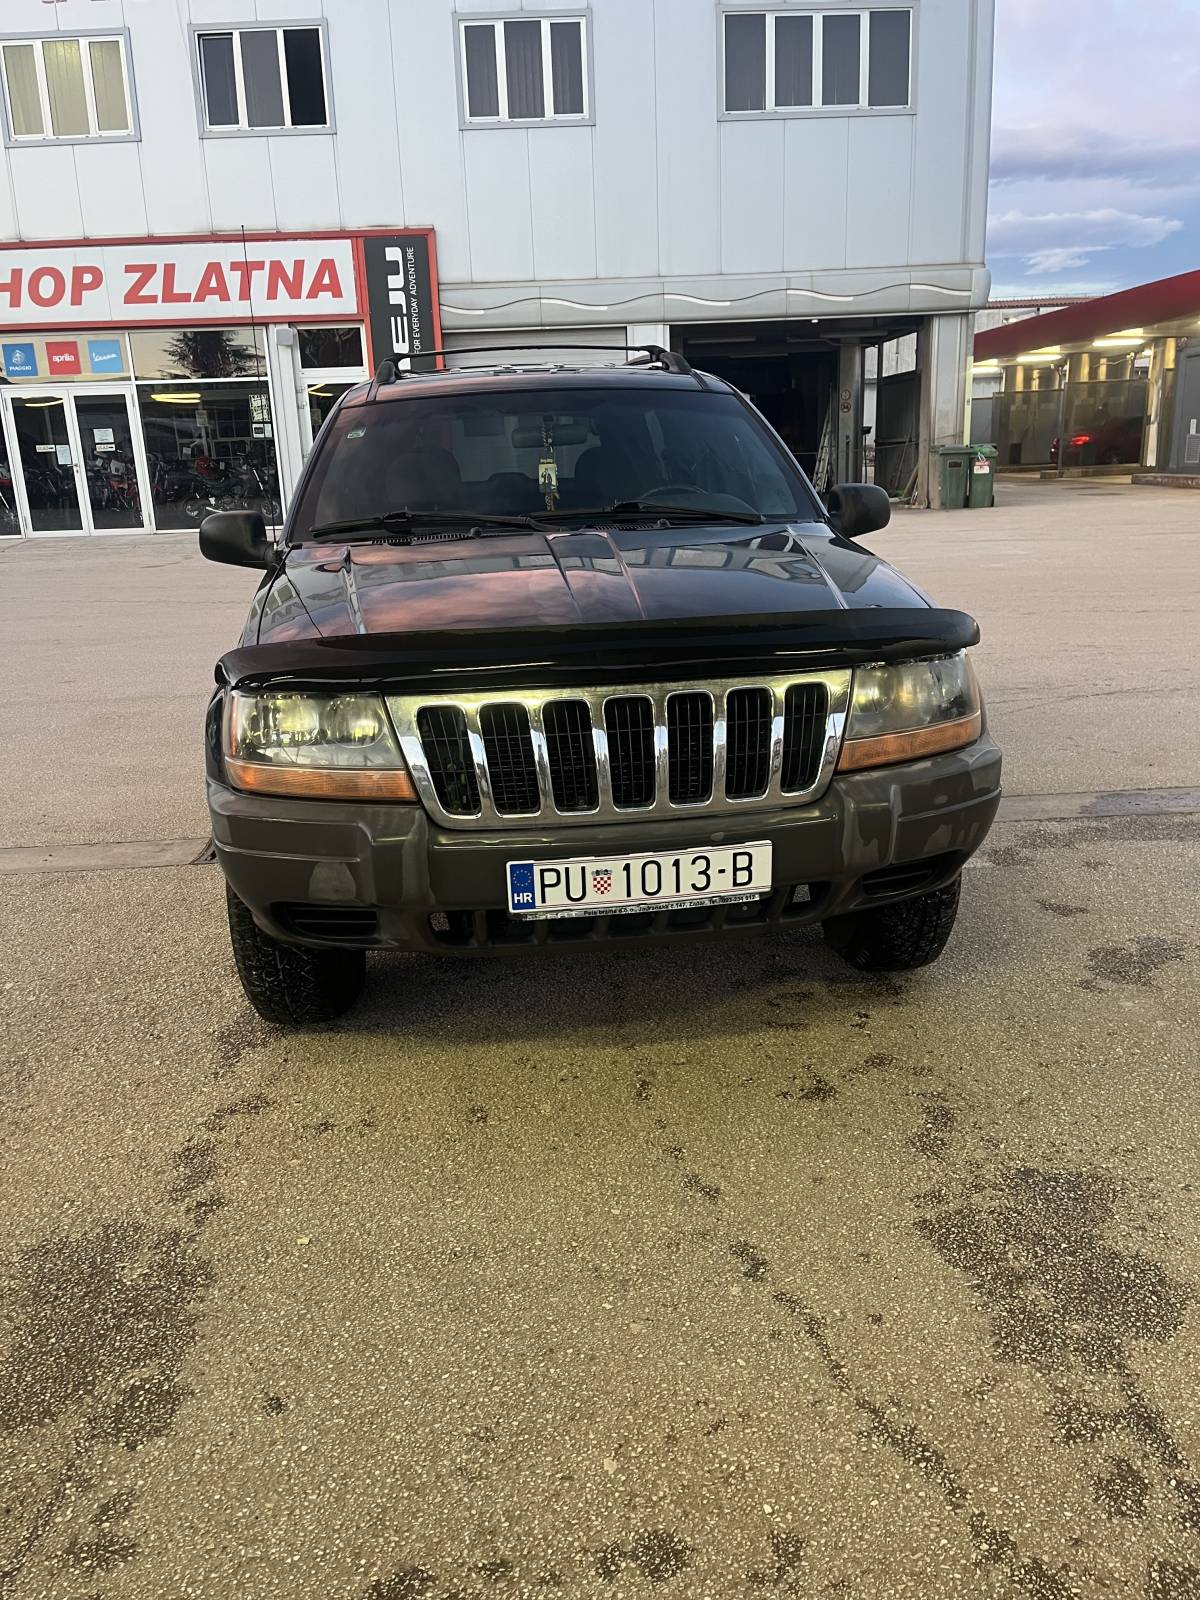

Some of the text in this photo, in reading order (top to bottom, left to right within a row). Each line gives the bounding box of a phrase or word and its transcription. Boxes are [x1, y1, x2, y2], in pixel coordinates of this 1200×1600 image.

[123, 258, 344, 305] ZLATNA
[406, 247, 421, 354] FOR EVERYDAY ADVENTURE
[52, 353, 75, 363] aprilia
[513, 893, 532, 904] HR
[540, 851, 753, 904] PU 1013-B
